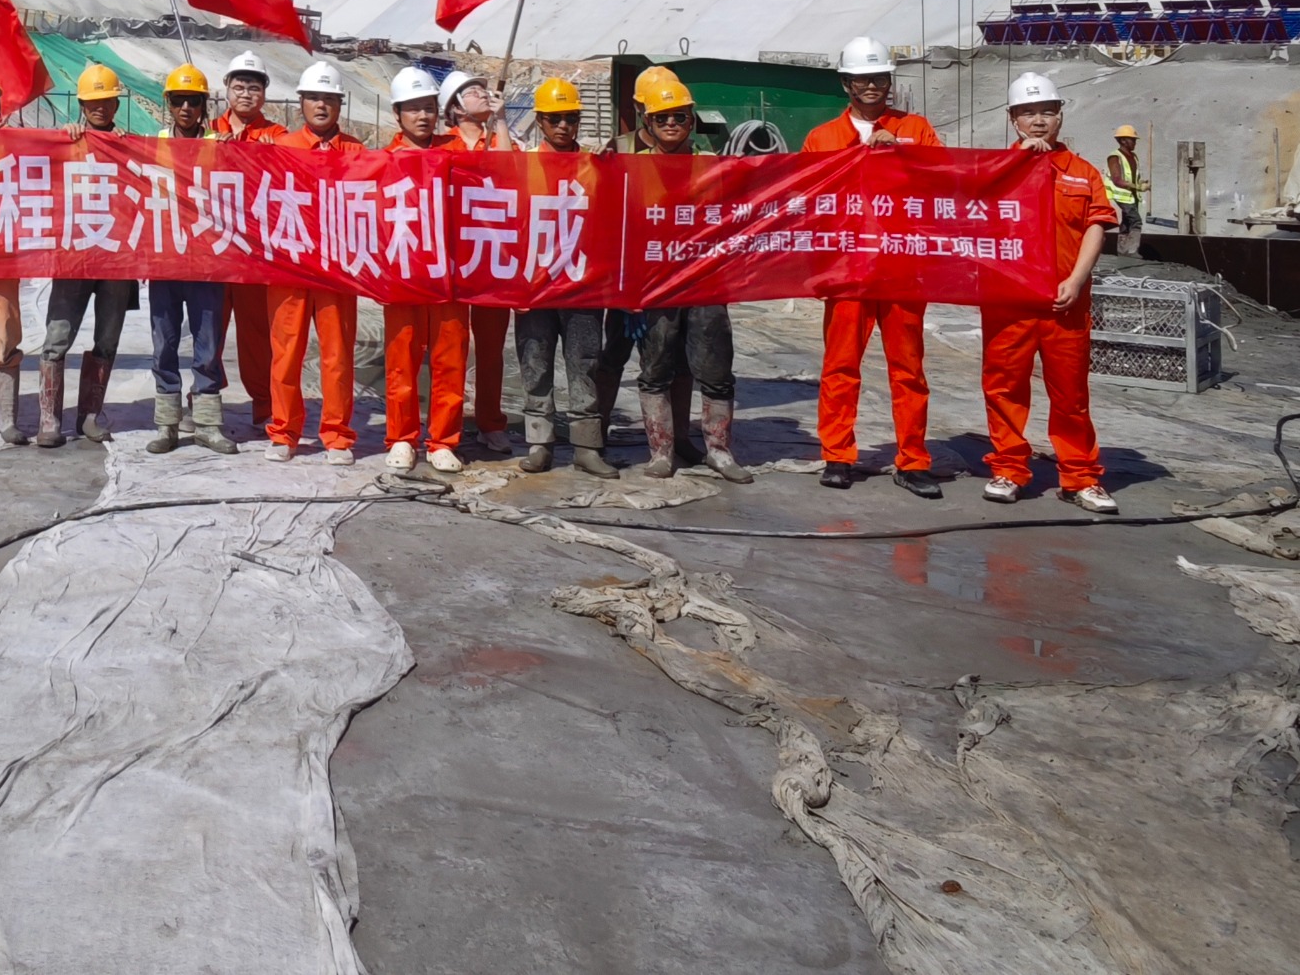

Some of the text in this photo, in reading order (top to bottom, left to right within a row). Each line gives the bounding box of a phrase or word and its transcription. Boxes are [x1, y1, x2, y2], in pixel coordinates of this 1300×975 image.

[644, 229, 1023, 262] 昌化江水资源配置工程二标施工项目部
